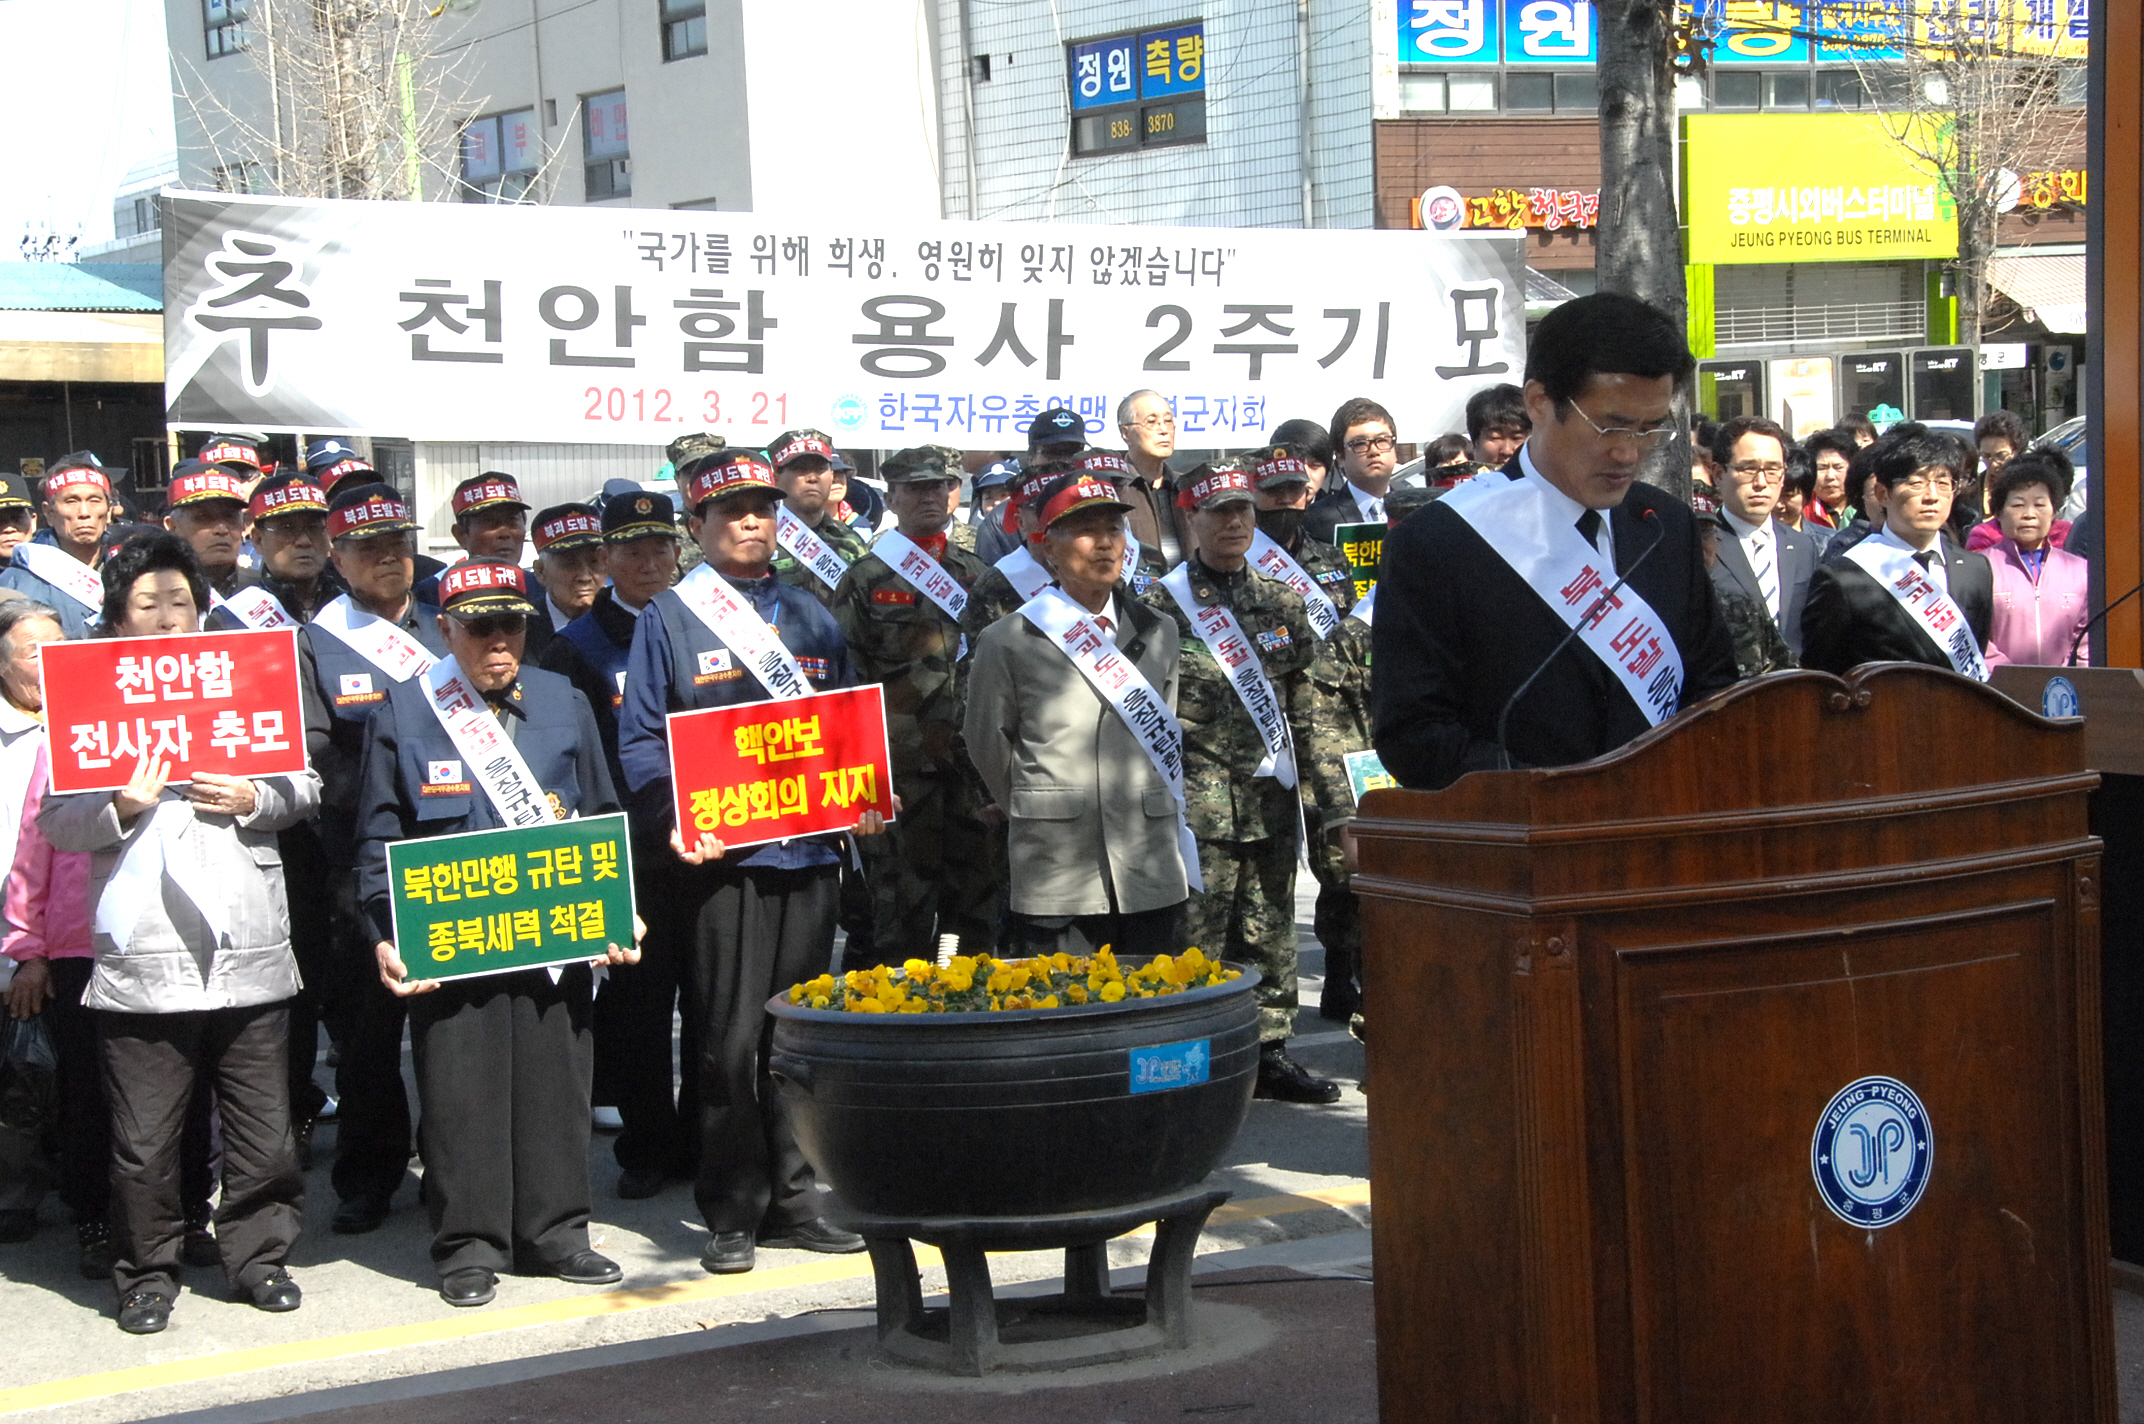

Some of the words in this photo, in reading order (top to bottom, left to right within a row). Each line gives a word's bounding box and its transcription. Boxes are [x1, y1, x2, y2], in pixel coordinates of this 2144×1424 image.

[1411, 0, 1590, 57] 정원
[1079, 48, 1131, 97] 정원
[1146, 34, 1203, 84] 측량
[1148, 113, 1174, 133] 3870
[1471, 189, 1527, 230] 고향
[1727, 184, 1935, 225] 증평시외버스터미널
[749, 234, 810, 278] 위해
[827, 237, 900, 280] 희생.
[918, 239, 1003, 284] 영원히
[1020, 243, 1074, 284] 잊지
[1731, 232, 1775, 247] JEUNG
[1779, 230, 1832, 246] PYEONG
[1837, 230, 1863, 244] BUS
[1867, 228, 1932, 243] TERMINAL
[194, 238, 323, 386] 추
[397, 278, 778, 375] 천안함
[852, 294, 1075, 381] 용사
[1142, 300, 1392, 381] 2주기
[584, 386, 684, 422] 2012.
[702, 389, 733, 424] 3.
[751, 391, 788, 425] 21
[263, 489, 288, 508] 북괴
[289, 487, 311, 502] 도발
[463, 488, 485, 504] 북괴
[485, 485, 507, 499] 도발
[701, 470, 726, 490] 북괴
[726, 464, 752, 481] 도발
[1210, 474, 1231, 491] 도발
[344, 505, 370, 525] 북괴
[370, 502, 395, 519] 도발
[544, 519, 566, 539] 북괴
[566, 516, 589, 531] 도발
[465, 566, 491, 586] 도발
[495, 566, 517, 587] 규탄
[900, 551, 931, 581] 북괴
[926, 571, 954, 601] 도발
[1258, 548, 1290, 578] 북괴
[1895, 569, 1934, 605] 북괴
[1923, 597, 1957, 632] 도발
[1062, 620, 1103, 659] 북괴
[1196, 603, 1231, 637] 북괴
[1217, 634, 1250, 669] 도발
[1609, 616, 1665, 680] 도발
[115, 650, 235, 704] 천안함
[434, 677, 475, 720] 북괴
[69, 714, 193, 770] 전사자
[210, 710, 290, 759] 추모
[733, 714, 825, 766] 핵안보
[689, 774, 809, 832] 정상회의
[819, 763, 878, 809] 지지
[404, 853, 519, 905] 북한만행
[526, 845, 583, 890] 규탄
[590, 840, 619, 882] 및
[428, 908, 542, 962] 종북세력
[549, 899, 606, 942] 척결
[1828, 1088, 1865, 1130] JEUNG
[1871, 1086, 1918, 1120] PYEONG
